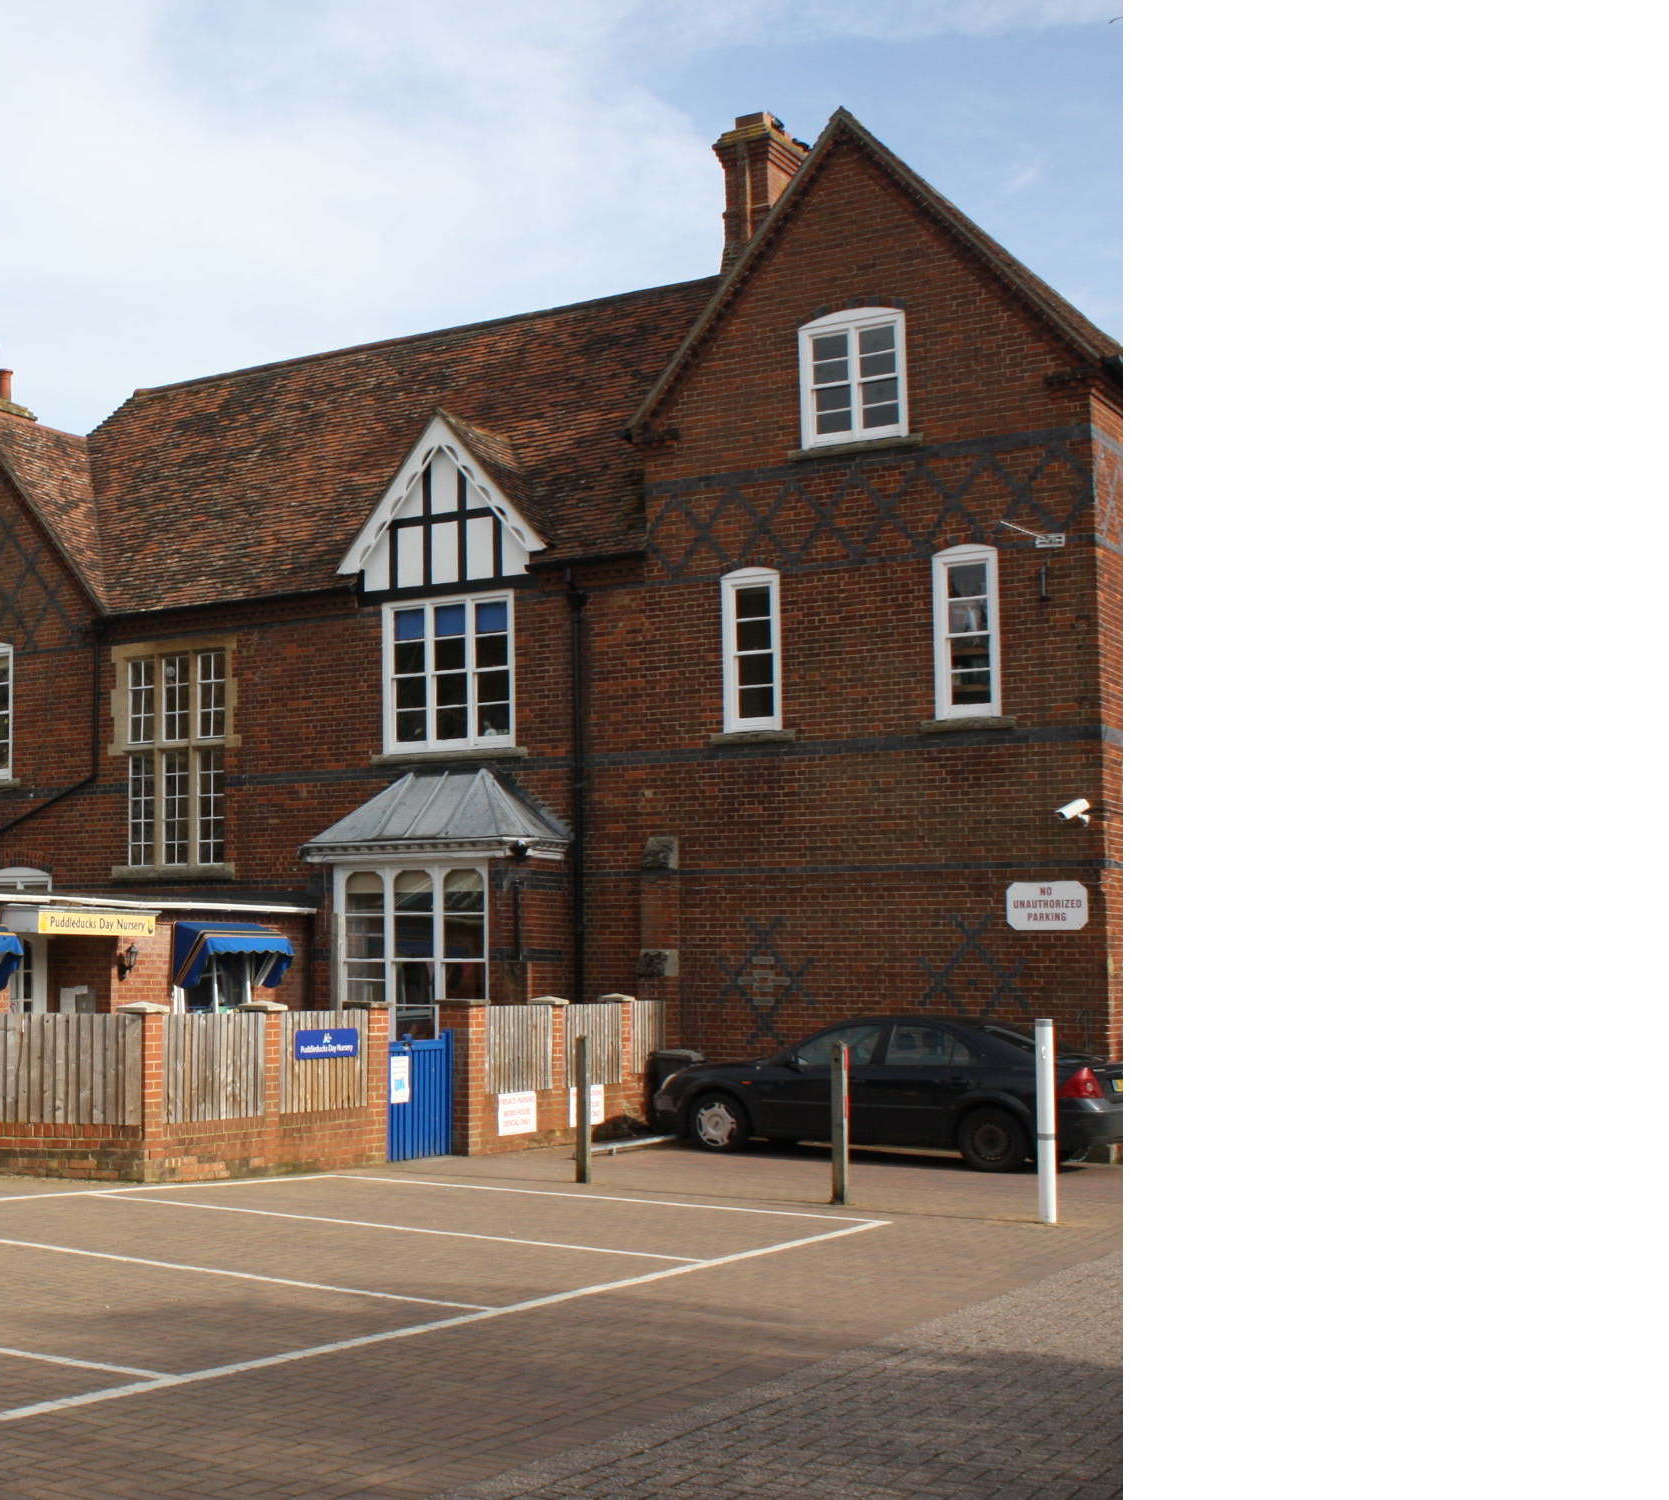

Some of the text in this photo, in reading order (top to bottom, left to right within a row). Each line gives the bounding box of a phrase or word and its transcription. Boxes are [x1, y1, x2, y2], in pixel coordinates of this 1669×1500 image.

[1039, 886, 1052, 896] NO
[1013, 899, 1082, 909] UNAUTHORIZED
[1027, 912, 1067, 921] PARKING
[50, 916, 145, 931] Puddleducks Day Nursery
